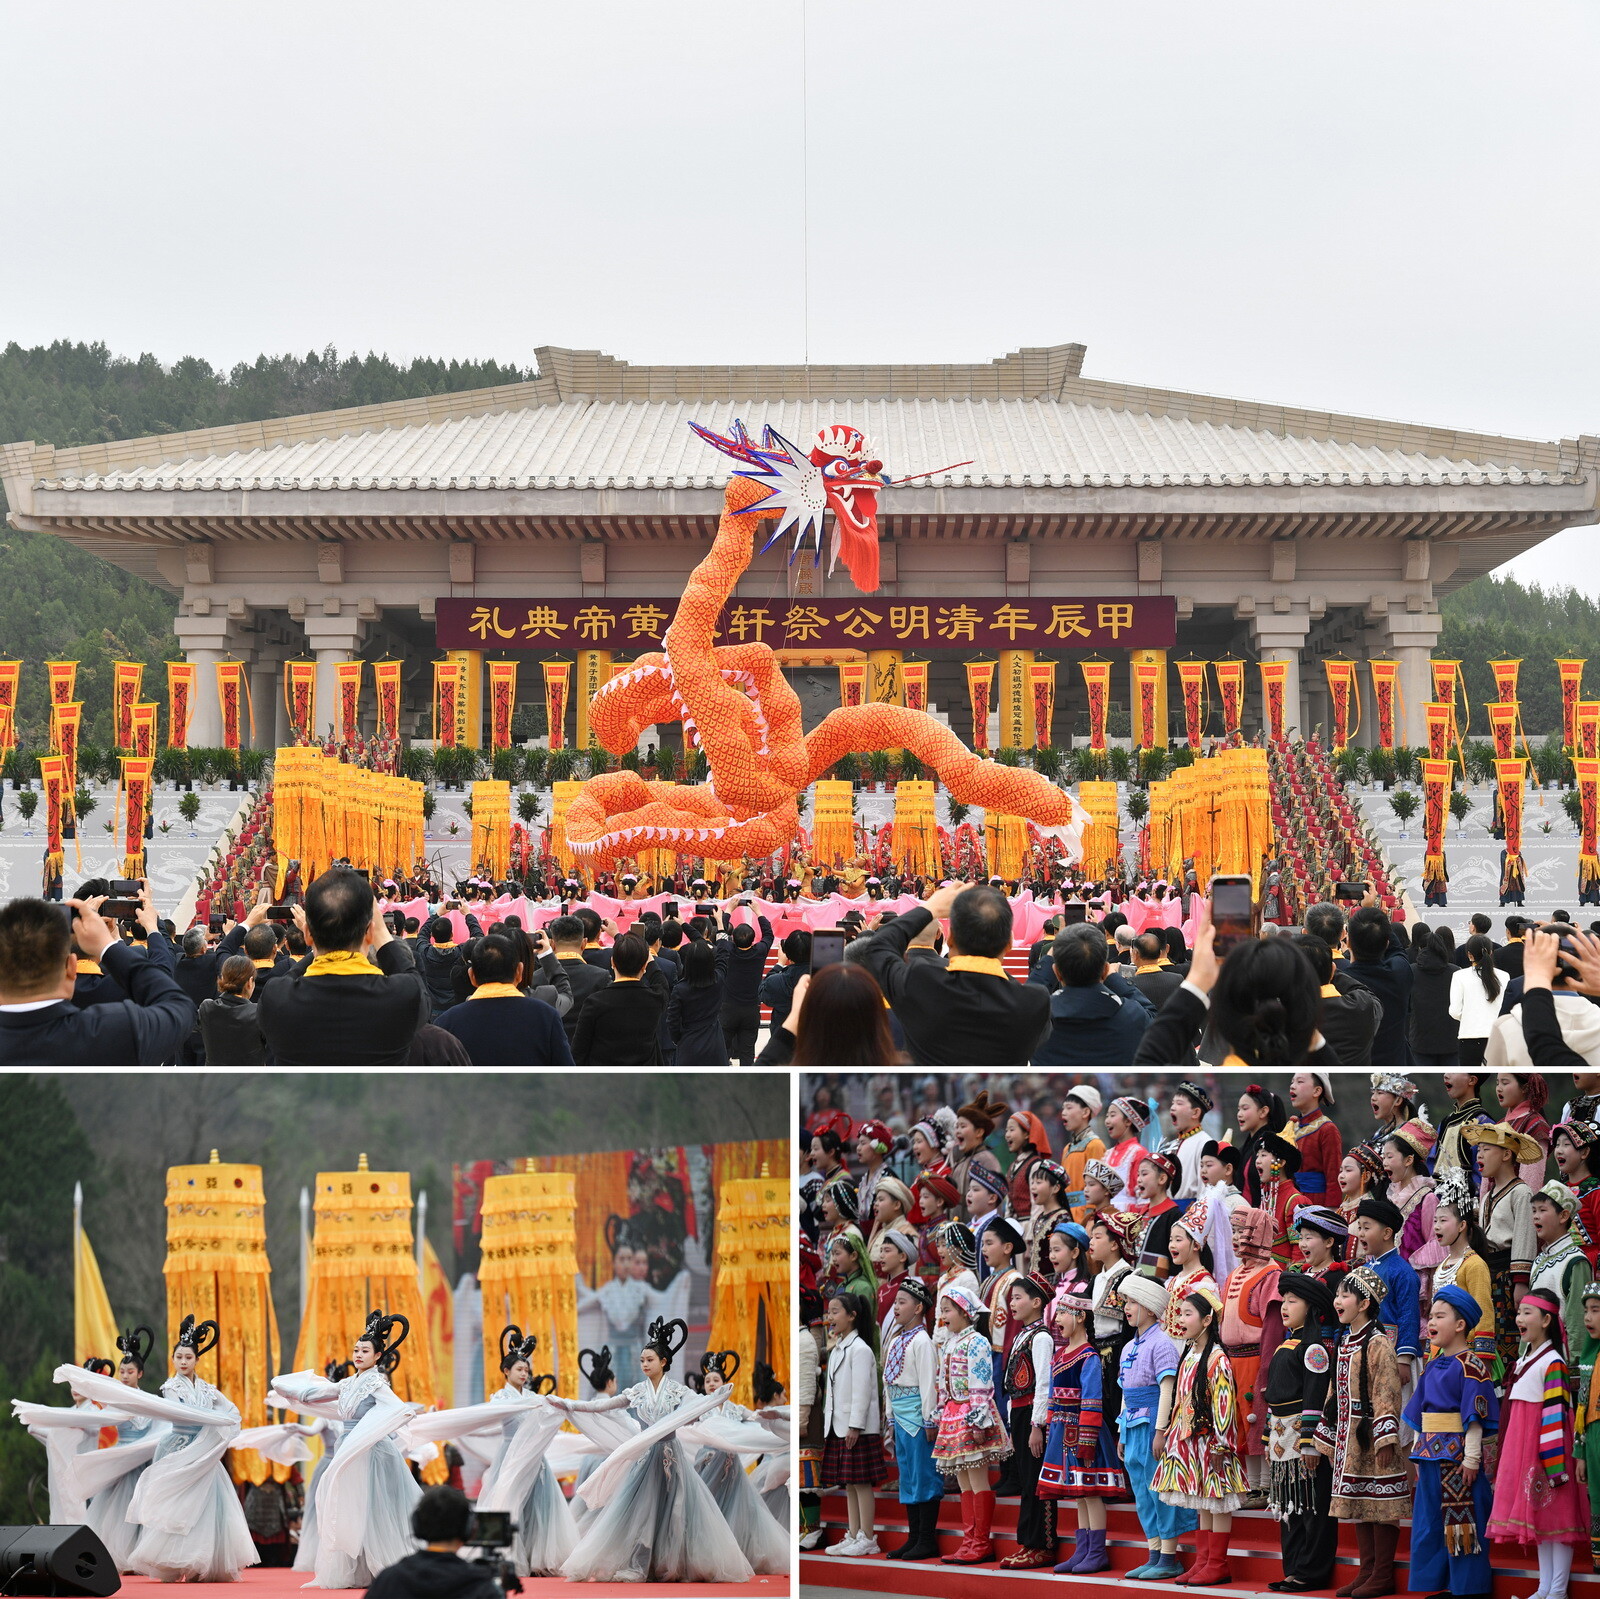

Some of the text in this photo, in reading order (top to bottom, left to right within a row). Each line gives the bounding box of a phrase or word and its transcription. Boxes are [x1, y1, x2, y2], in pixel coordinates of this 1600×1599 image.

[468, 603, 1134, 641] 甲辰年清明公祭轩黄帝典礼
